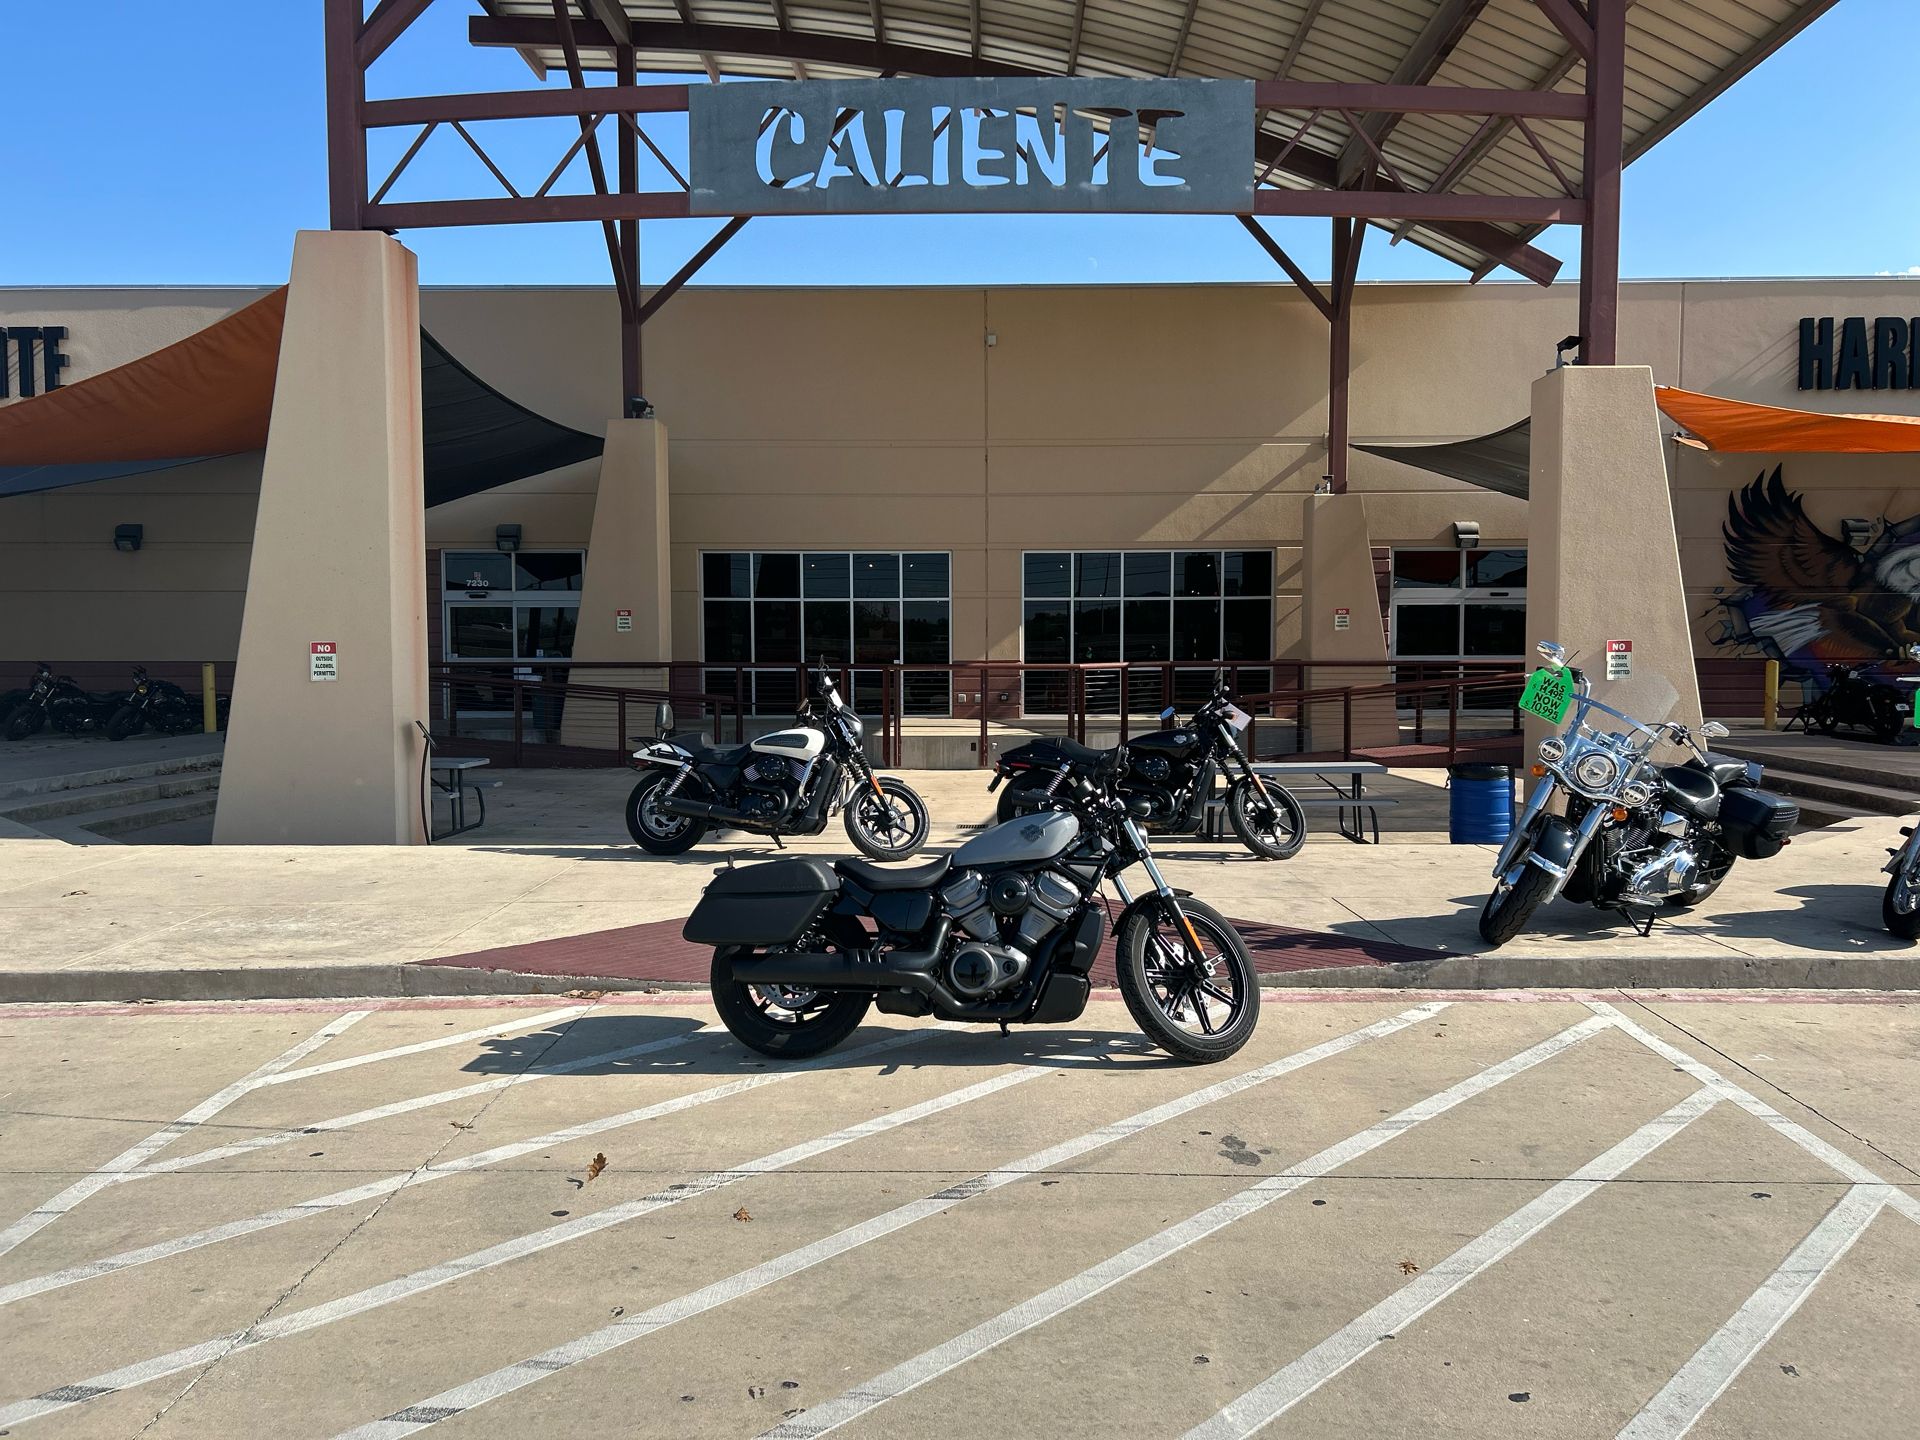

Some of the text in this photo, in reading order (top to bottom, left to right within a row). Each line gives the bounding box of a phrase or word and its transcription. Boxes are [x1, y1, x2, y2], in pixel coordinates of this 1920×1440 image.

[755, 103, 1186, 189] CALIENTE
[0, 326, 70, 398] TE
[466, 579, 489, 587] 7230
[317, 644, 331, 652] NO
[1612, 643, 1626, 651] NO
[1543, 676, 1566, 693] WAS
[1533, 692, 1561, 710] NOW
